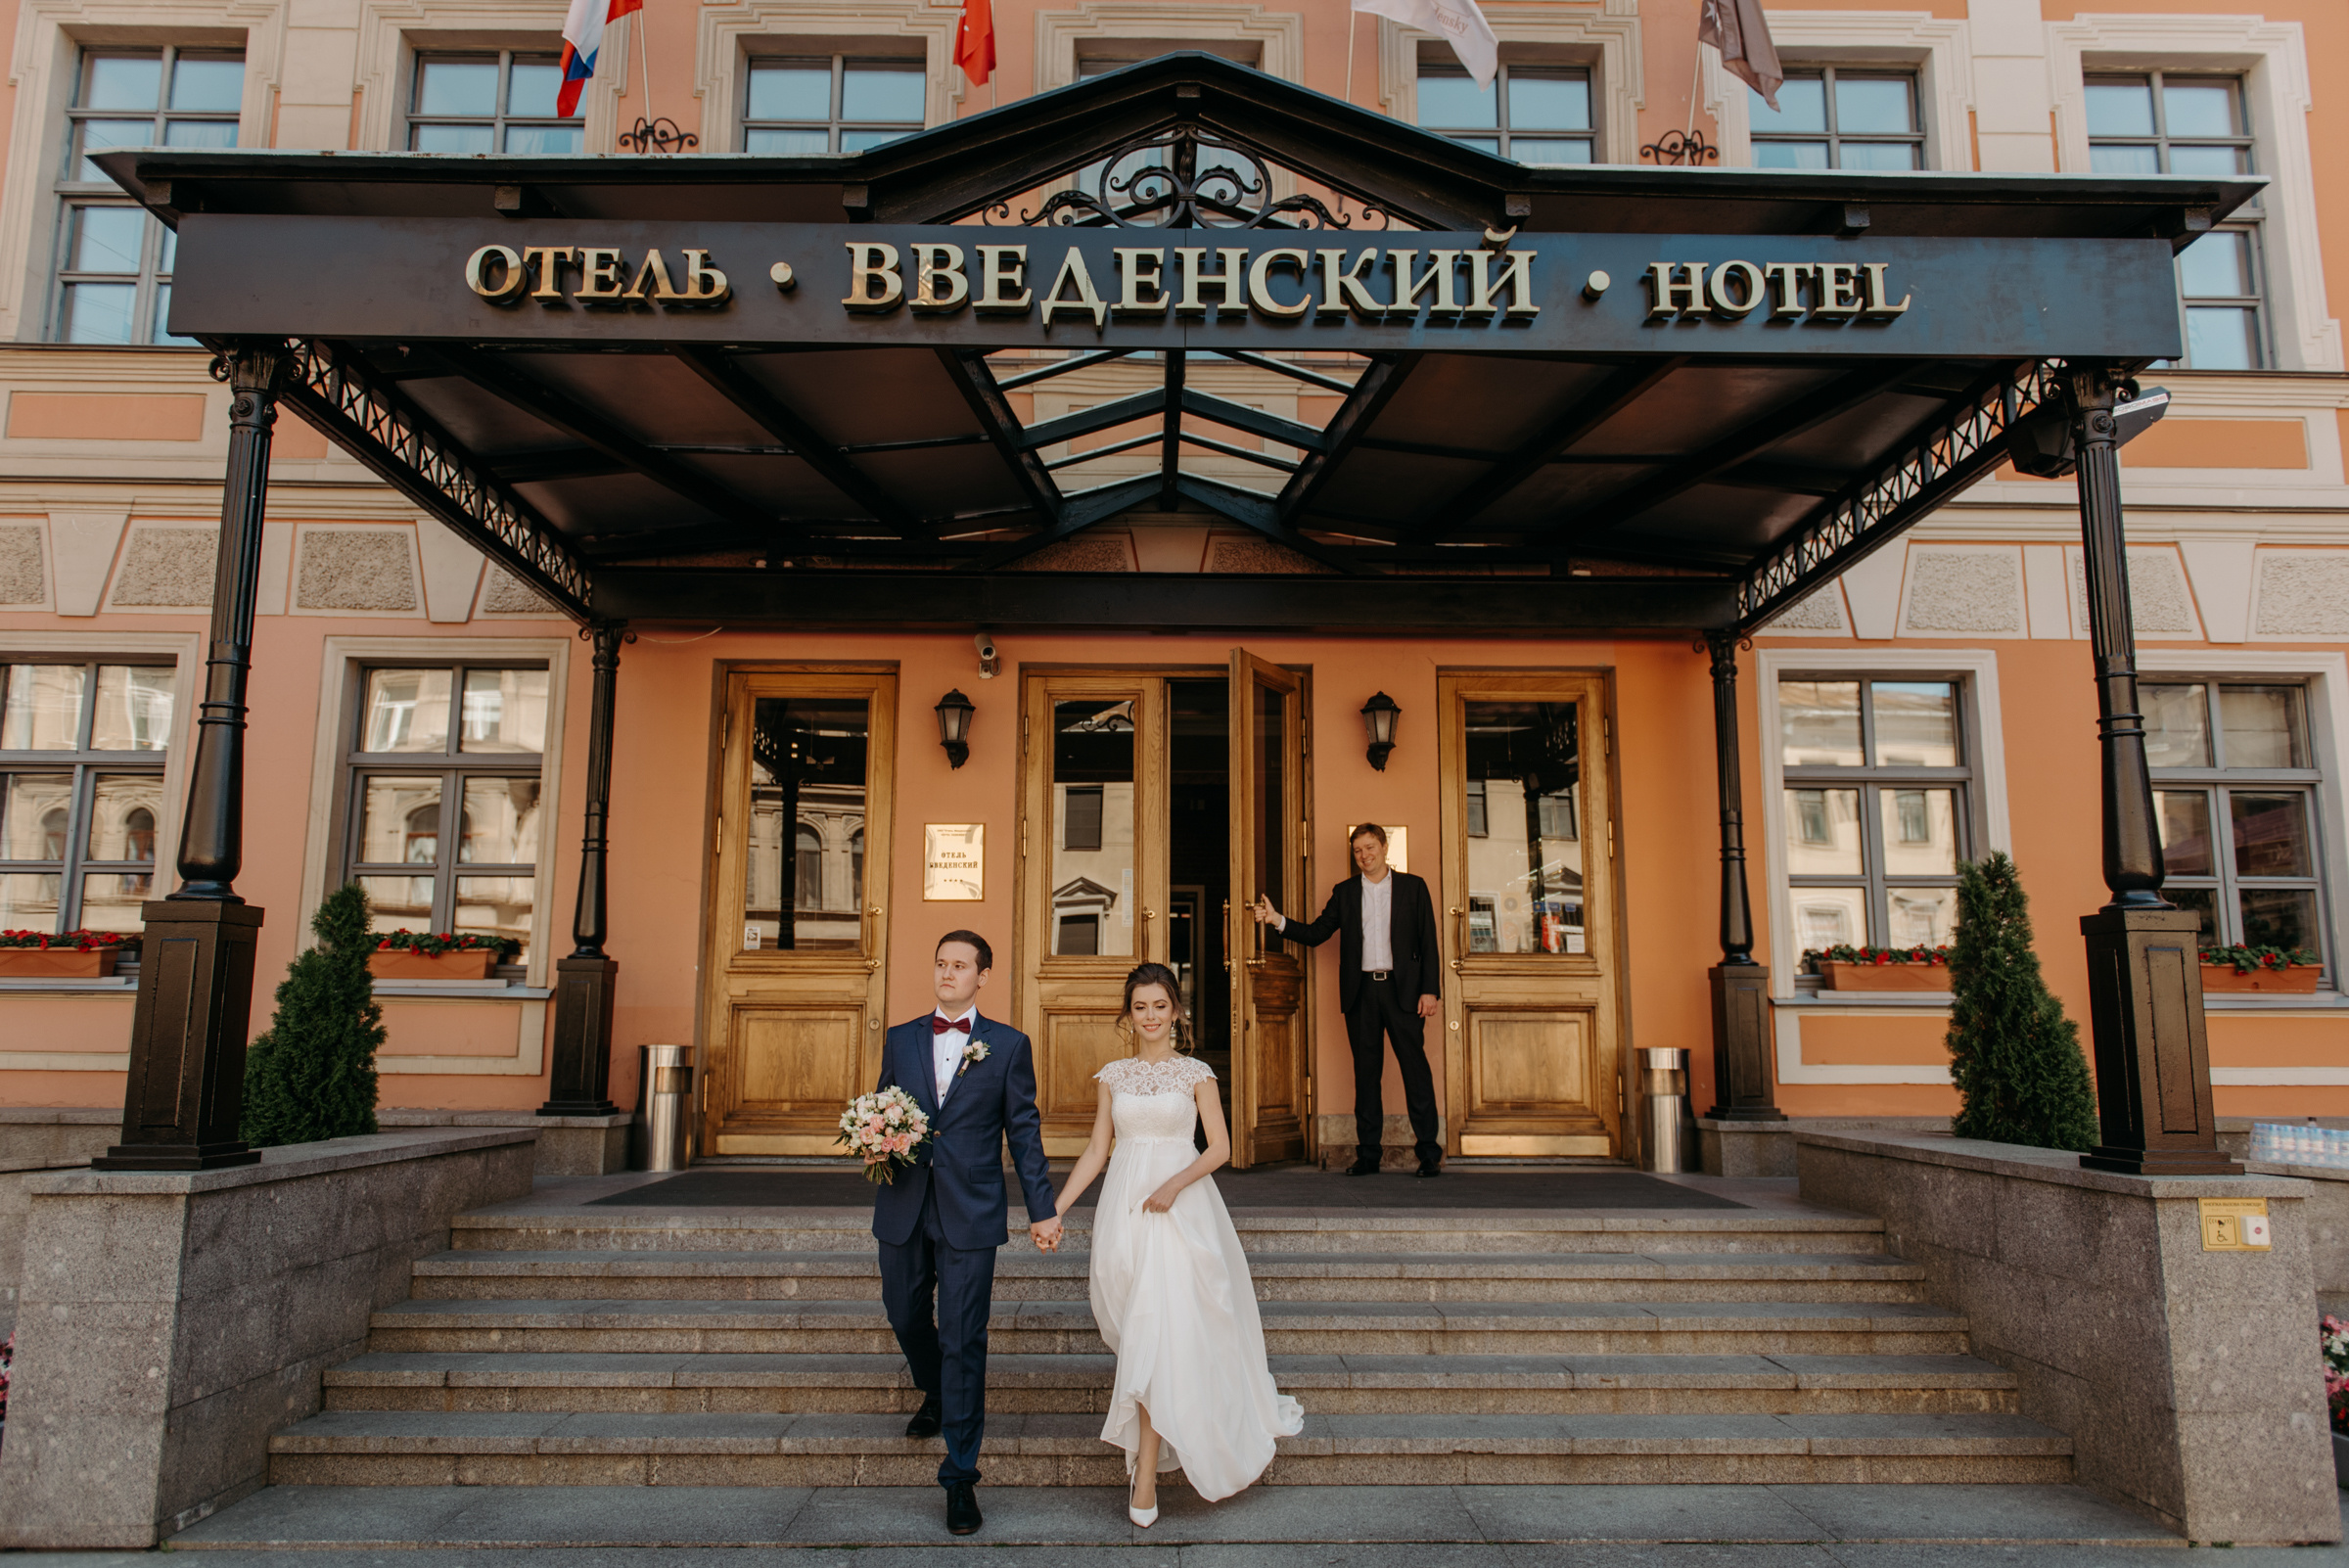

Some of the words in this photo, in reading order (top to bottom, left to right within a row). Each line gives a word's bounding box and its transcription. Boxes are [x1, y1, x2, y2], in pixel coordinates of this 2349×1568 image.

[465, 244, 732, 305] ОТЕЛЬ
[841, 225, 1541, 333] ВВЕДЕНСКИЙ
[1649, 259, 1911, 320] HOTEL
